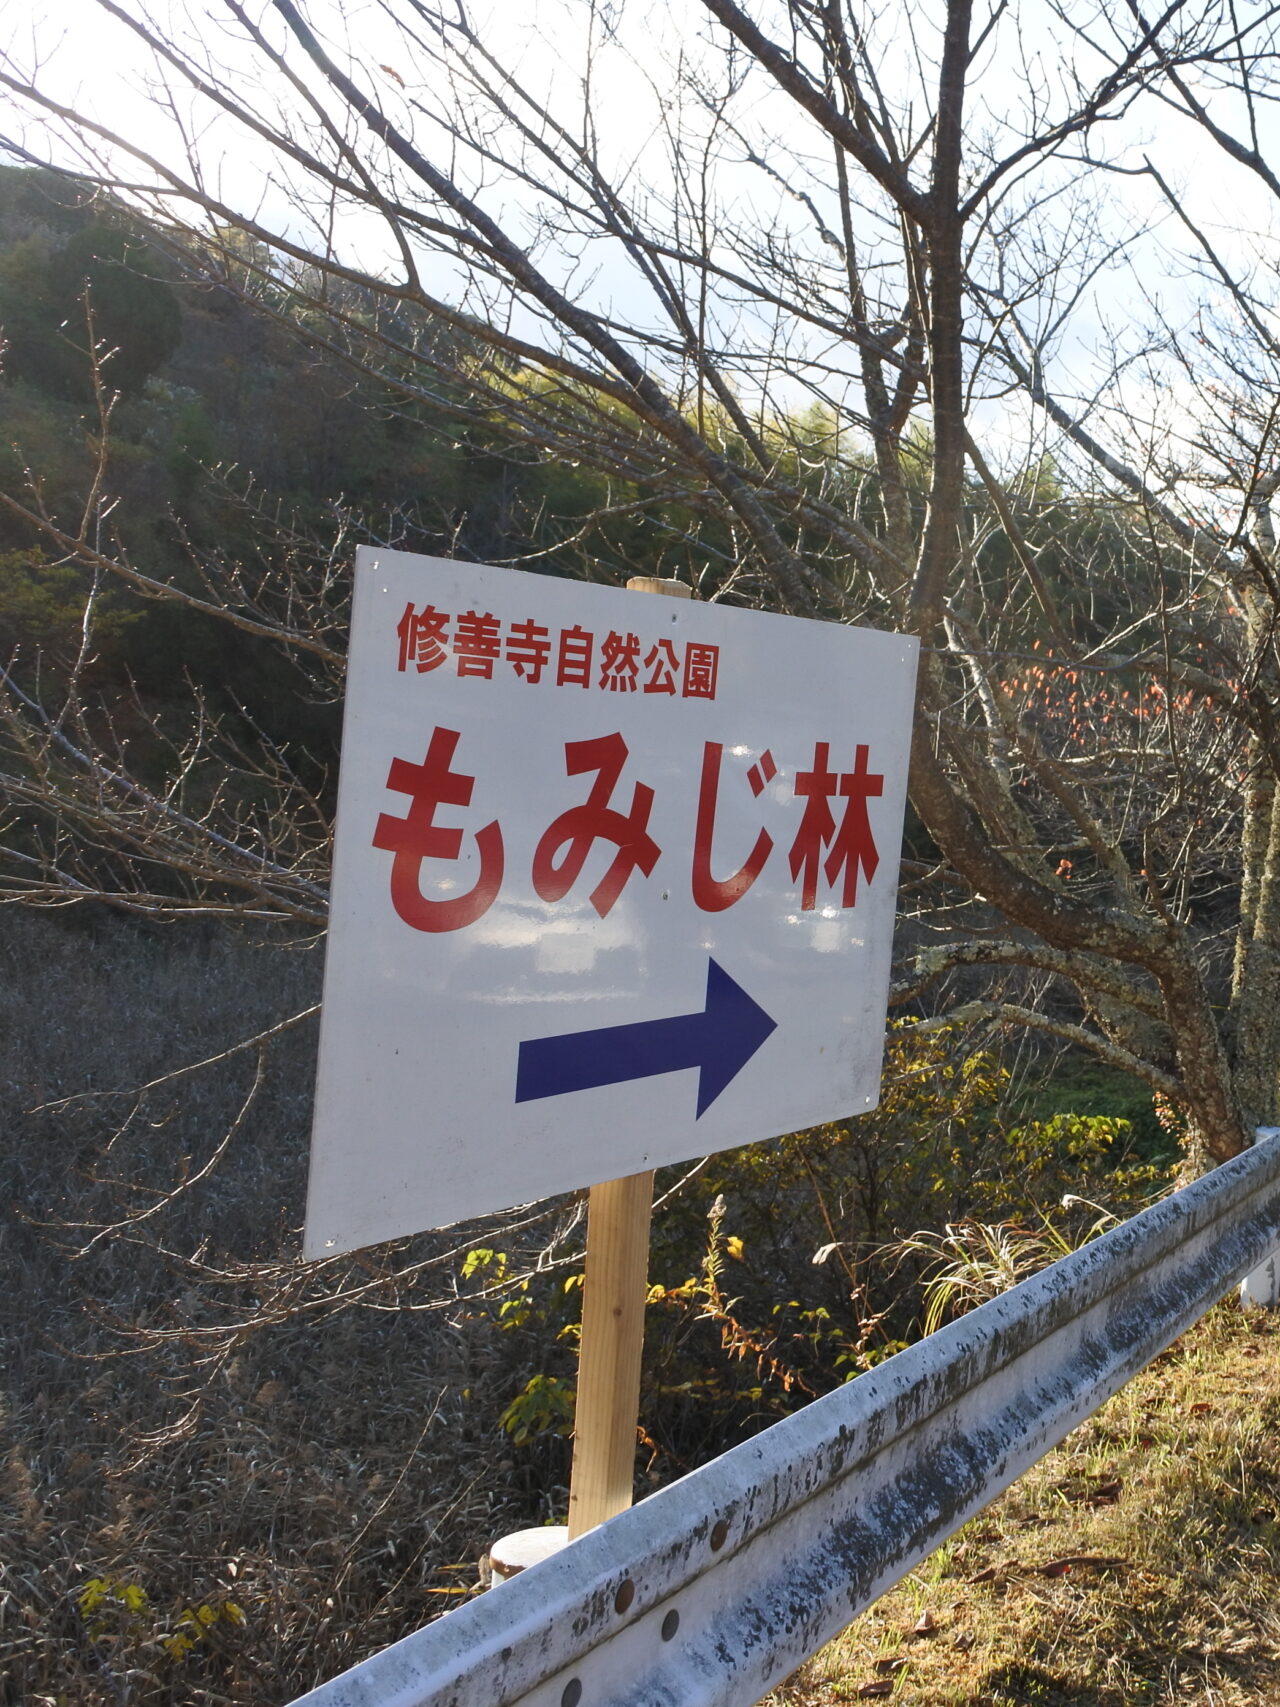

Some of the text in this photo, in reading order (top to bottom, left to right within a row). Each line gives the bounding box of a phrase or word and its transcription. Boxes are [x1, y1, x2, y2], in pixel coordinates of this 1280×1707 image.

[397, 602, 720, 700] 修善寺自然公園
[372, 726, 884, 933] もみじ林
